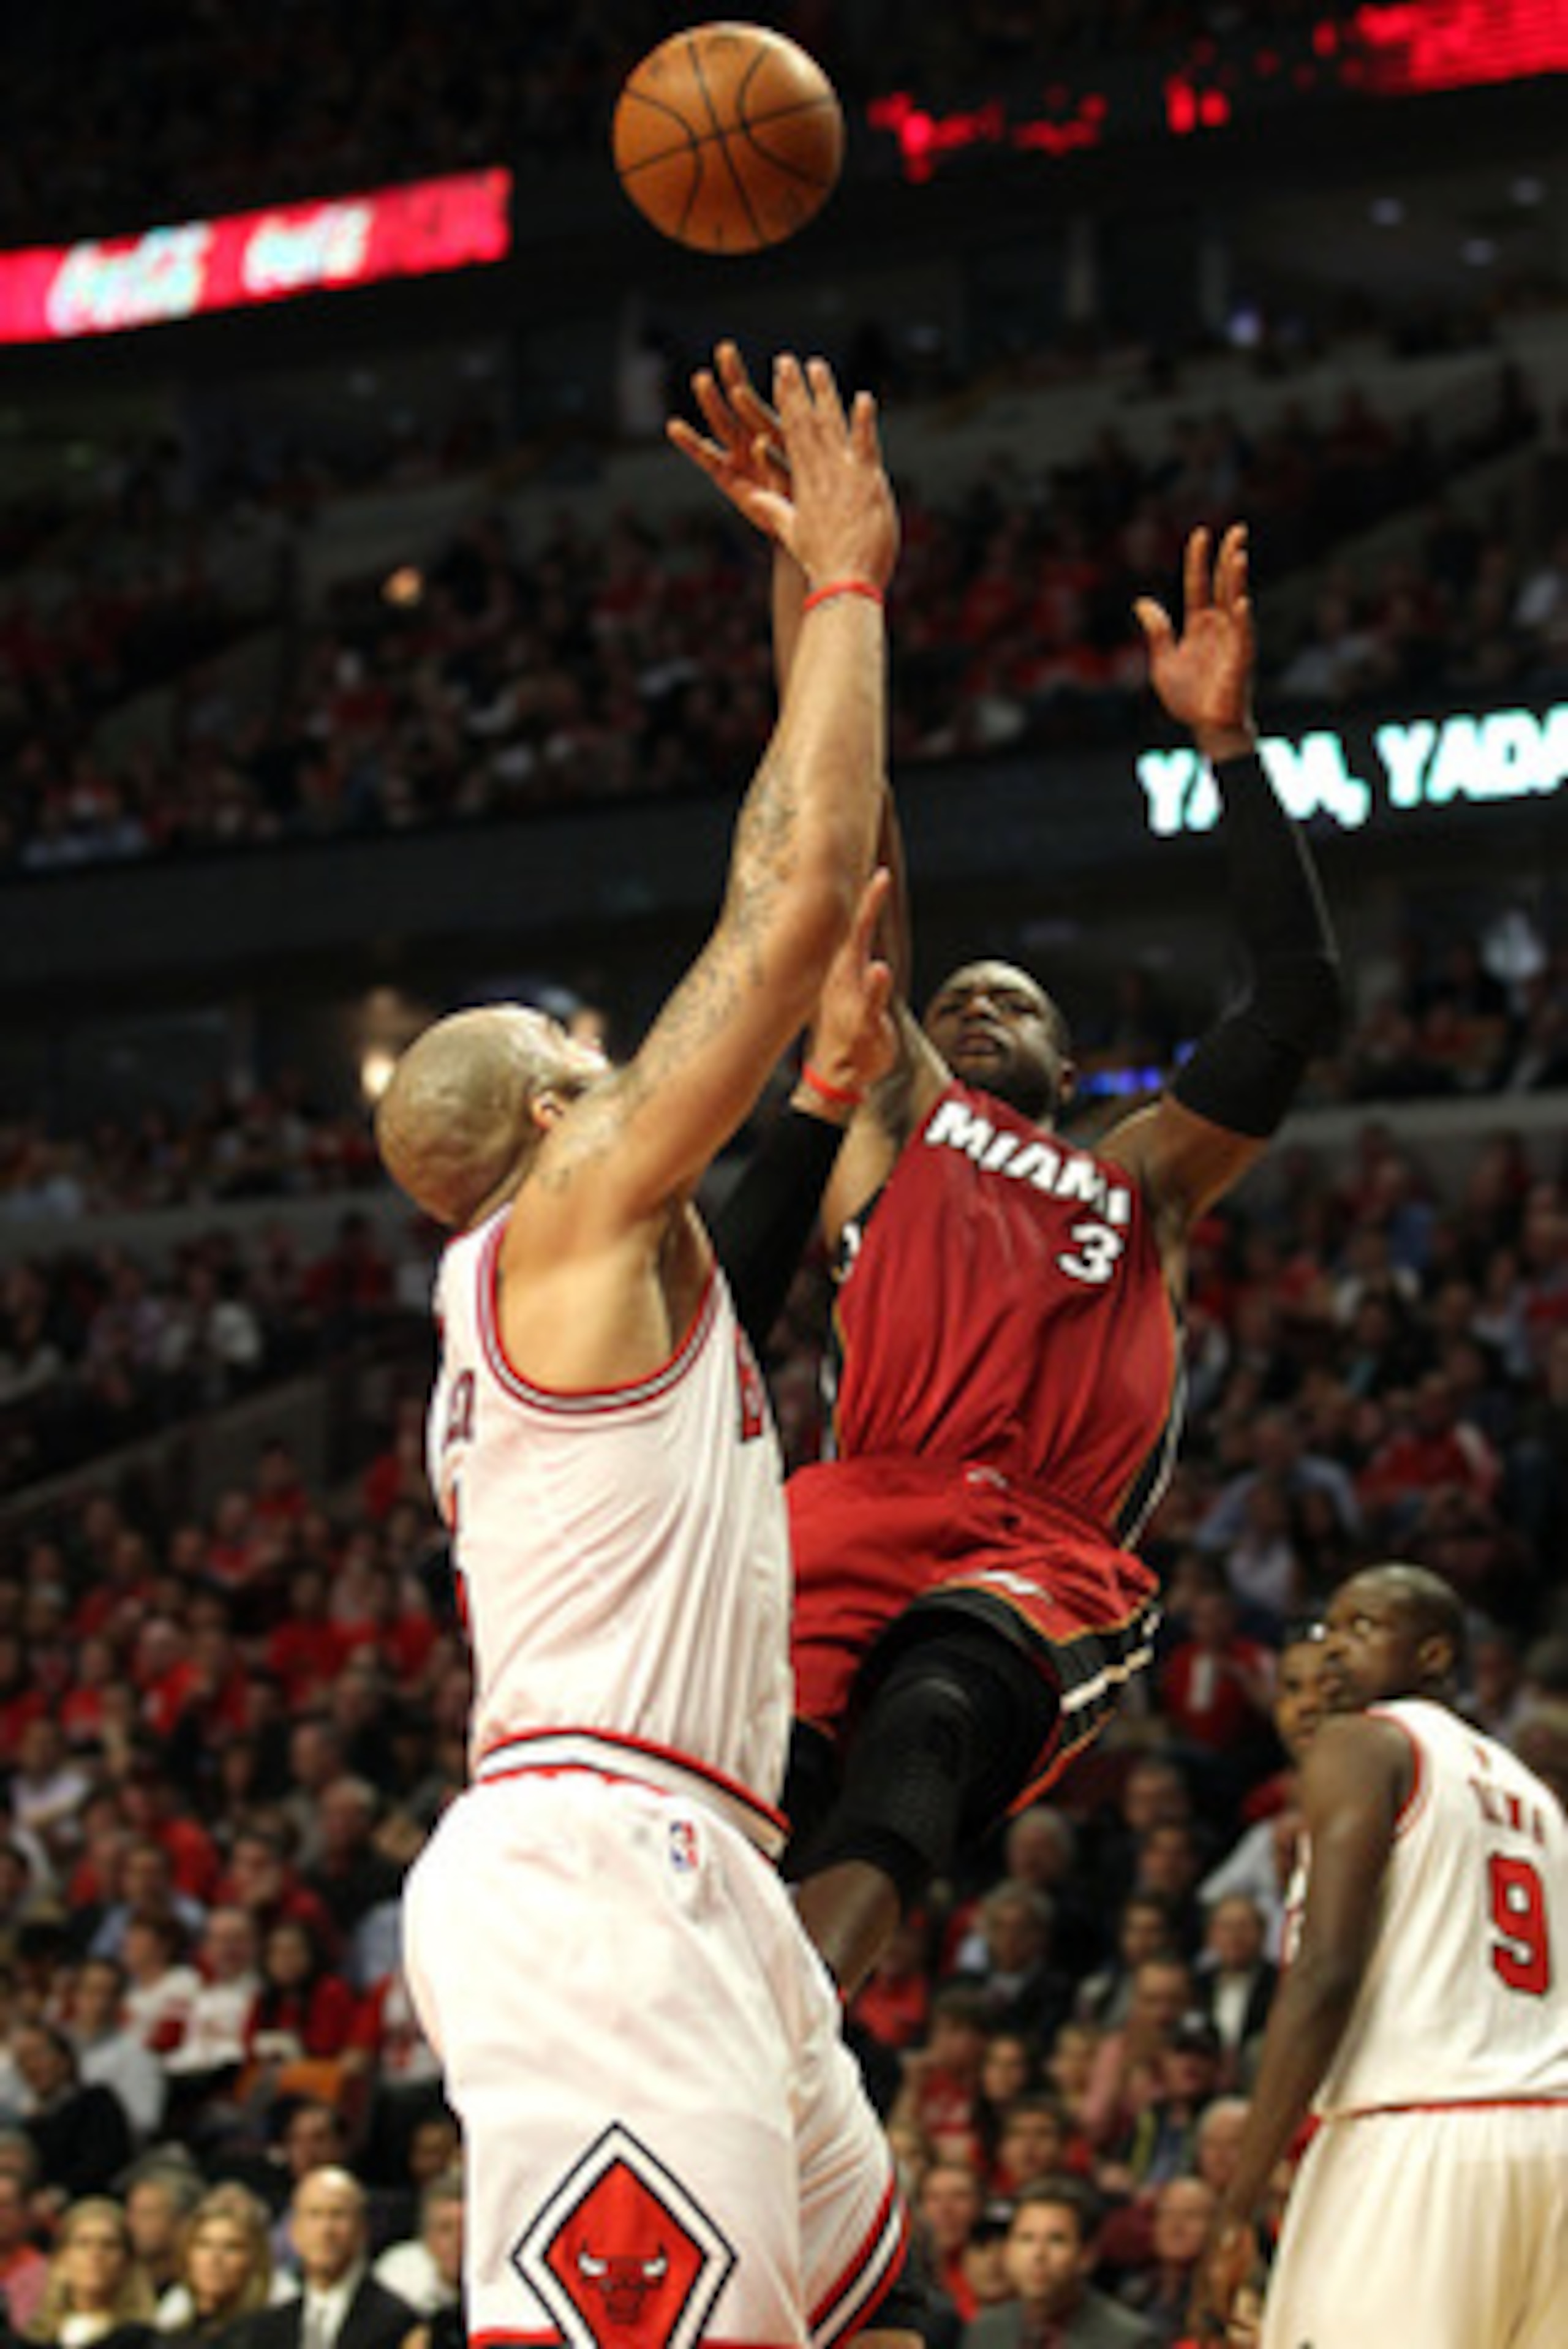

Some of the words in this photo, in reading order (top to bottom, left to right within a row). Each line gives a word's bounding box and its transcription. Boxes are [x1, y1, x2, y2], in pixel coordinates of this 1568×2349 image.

[924, 1100, 1129, 1224] MIAMI
[1057, 1224, 1122, 1284] 3
[1488, 1850, 1551, 1999] 9
